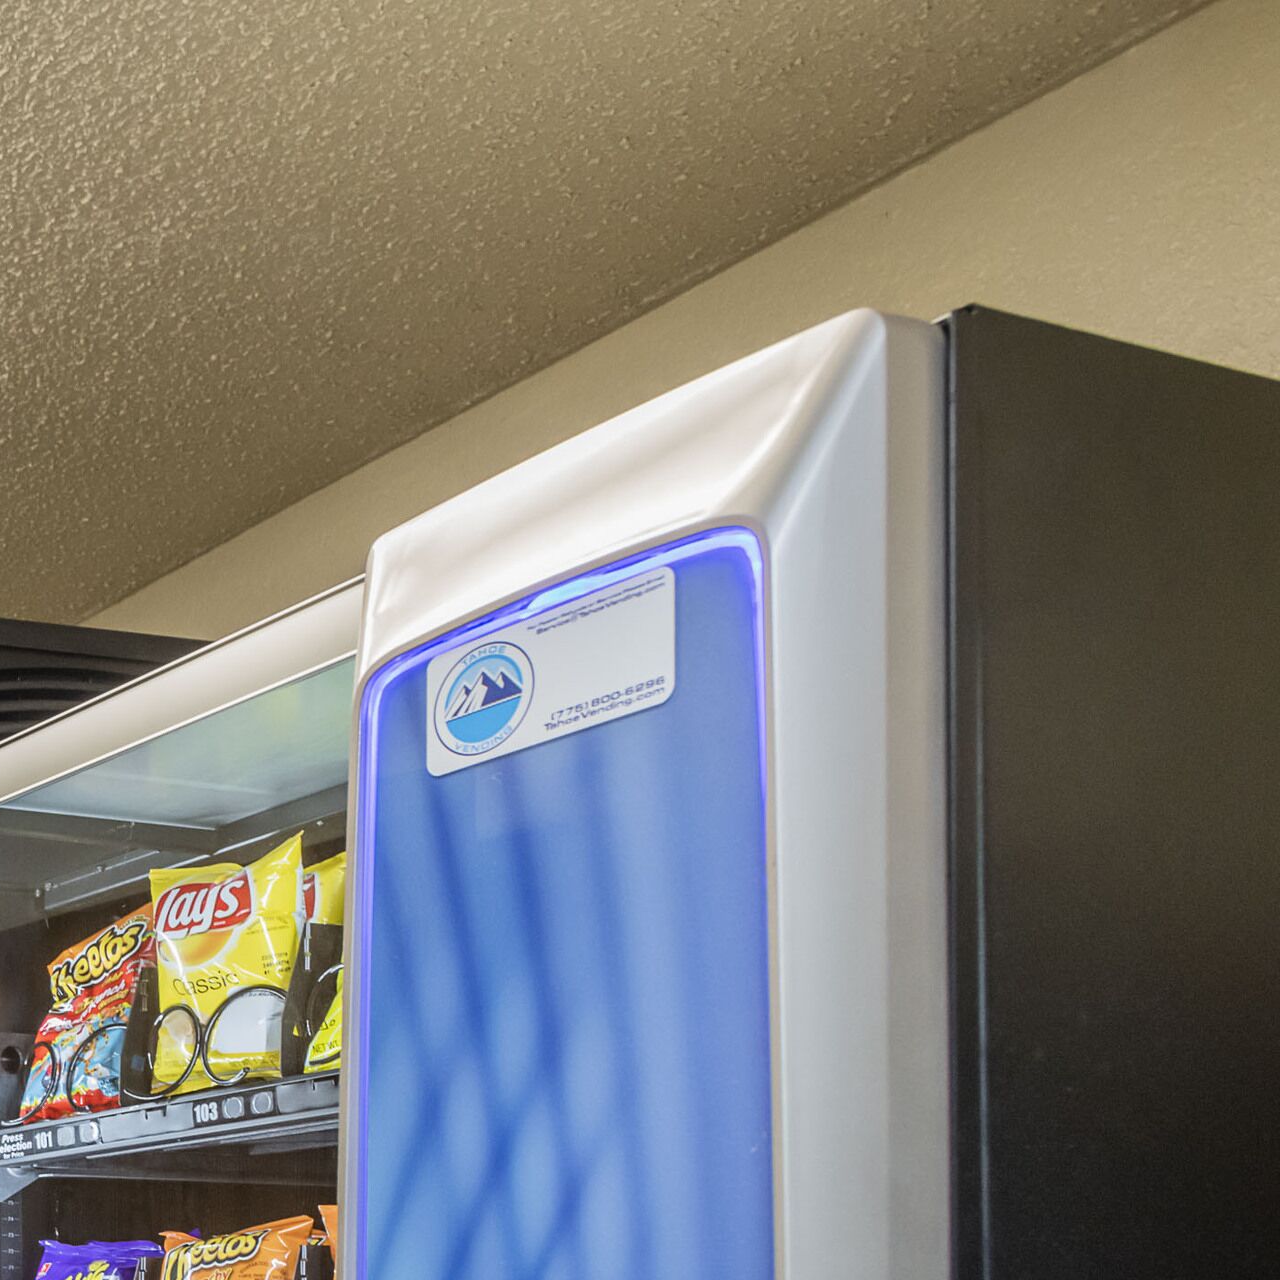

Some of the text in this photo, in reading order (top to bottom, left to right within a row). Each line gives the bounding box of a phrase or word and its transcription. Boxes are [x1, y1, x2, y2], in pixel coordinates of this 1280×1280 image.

[461, 645, 507, 666] TAHOE
[550, 702, 589, 721] (775)
[453, 725, 514, 753] VENDING
[193, 1102, 218, 1123] 103
[1, 1133, 24, 1144] Press
[34, 1131, 53, 1149] 101
